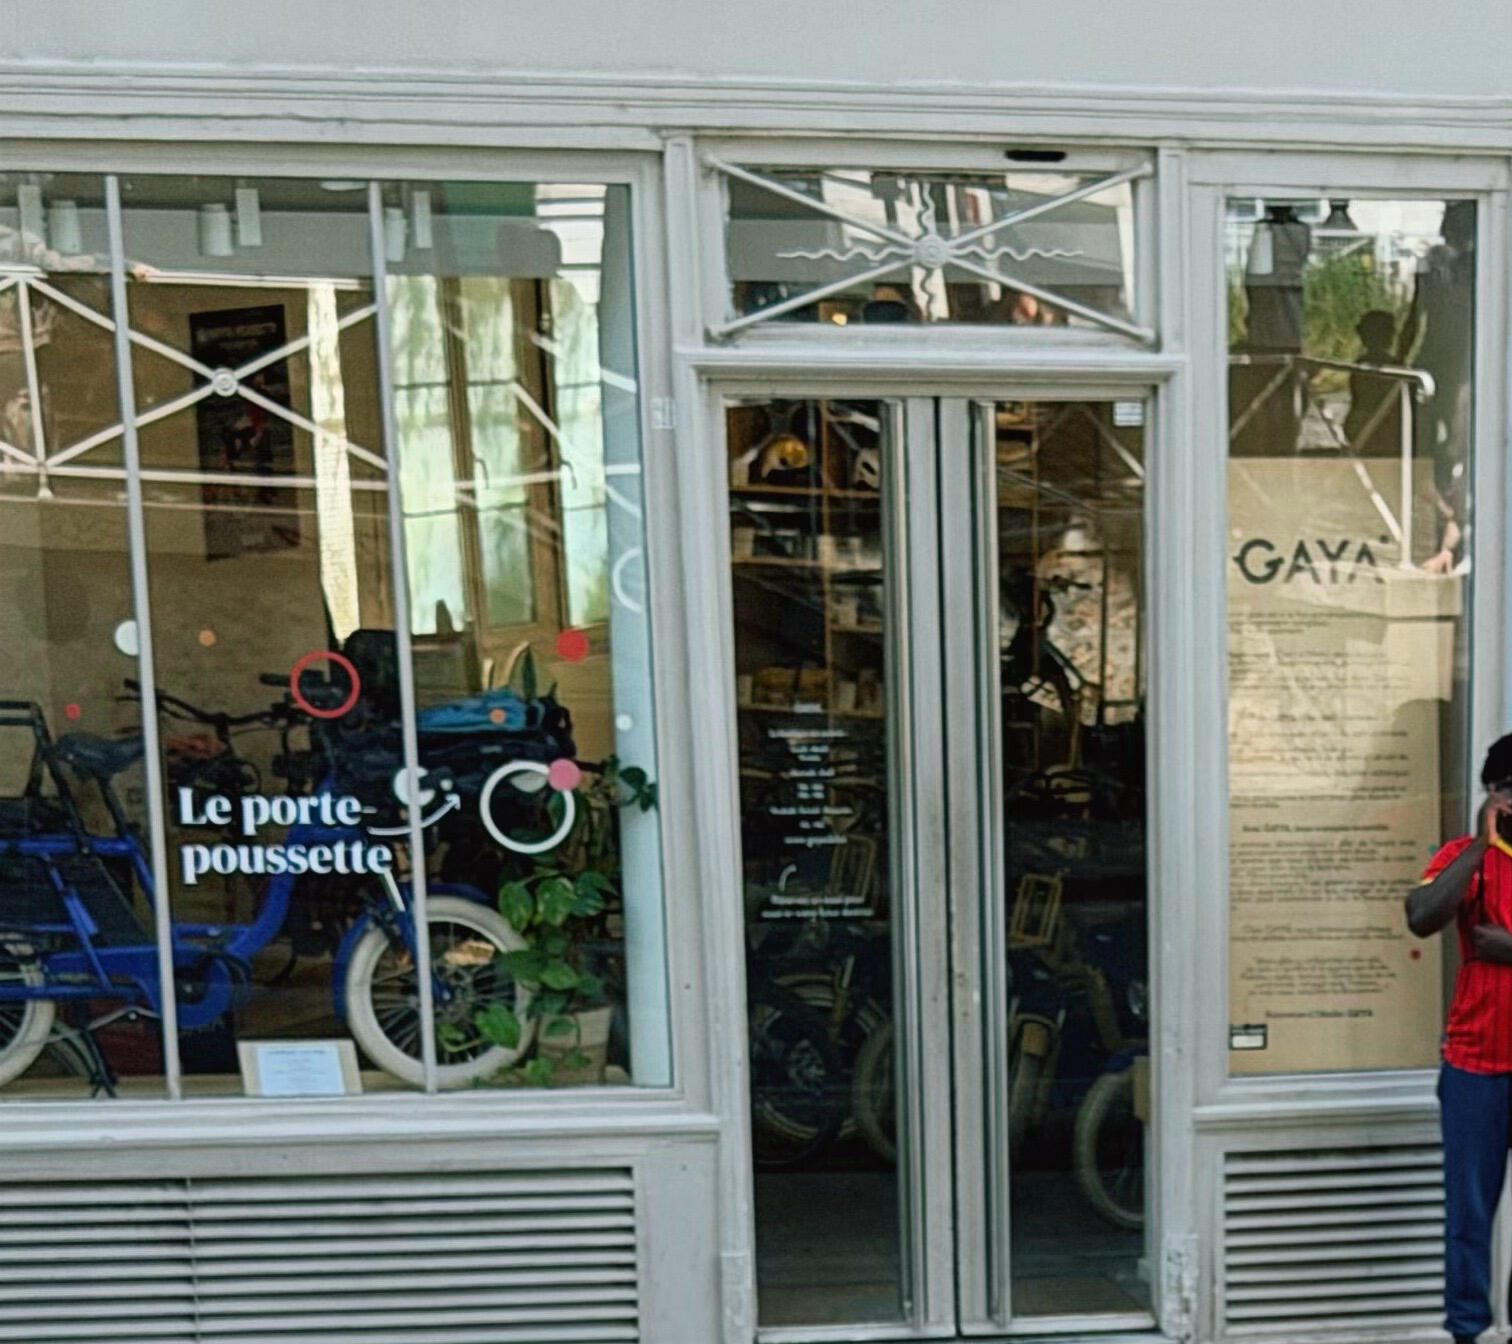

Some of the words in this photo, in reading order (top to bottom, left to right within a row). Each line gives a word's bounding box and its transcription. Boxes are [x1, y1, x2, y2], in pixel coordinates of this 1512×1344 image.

[1232, 538, 1385, 585] GAYA
[178, 786, 233, 825] Le
[241, 791, 377, 836] porte-
[181, 839, 393, 885] poussette
